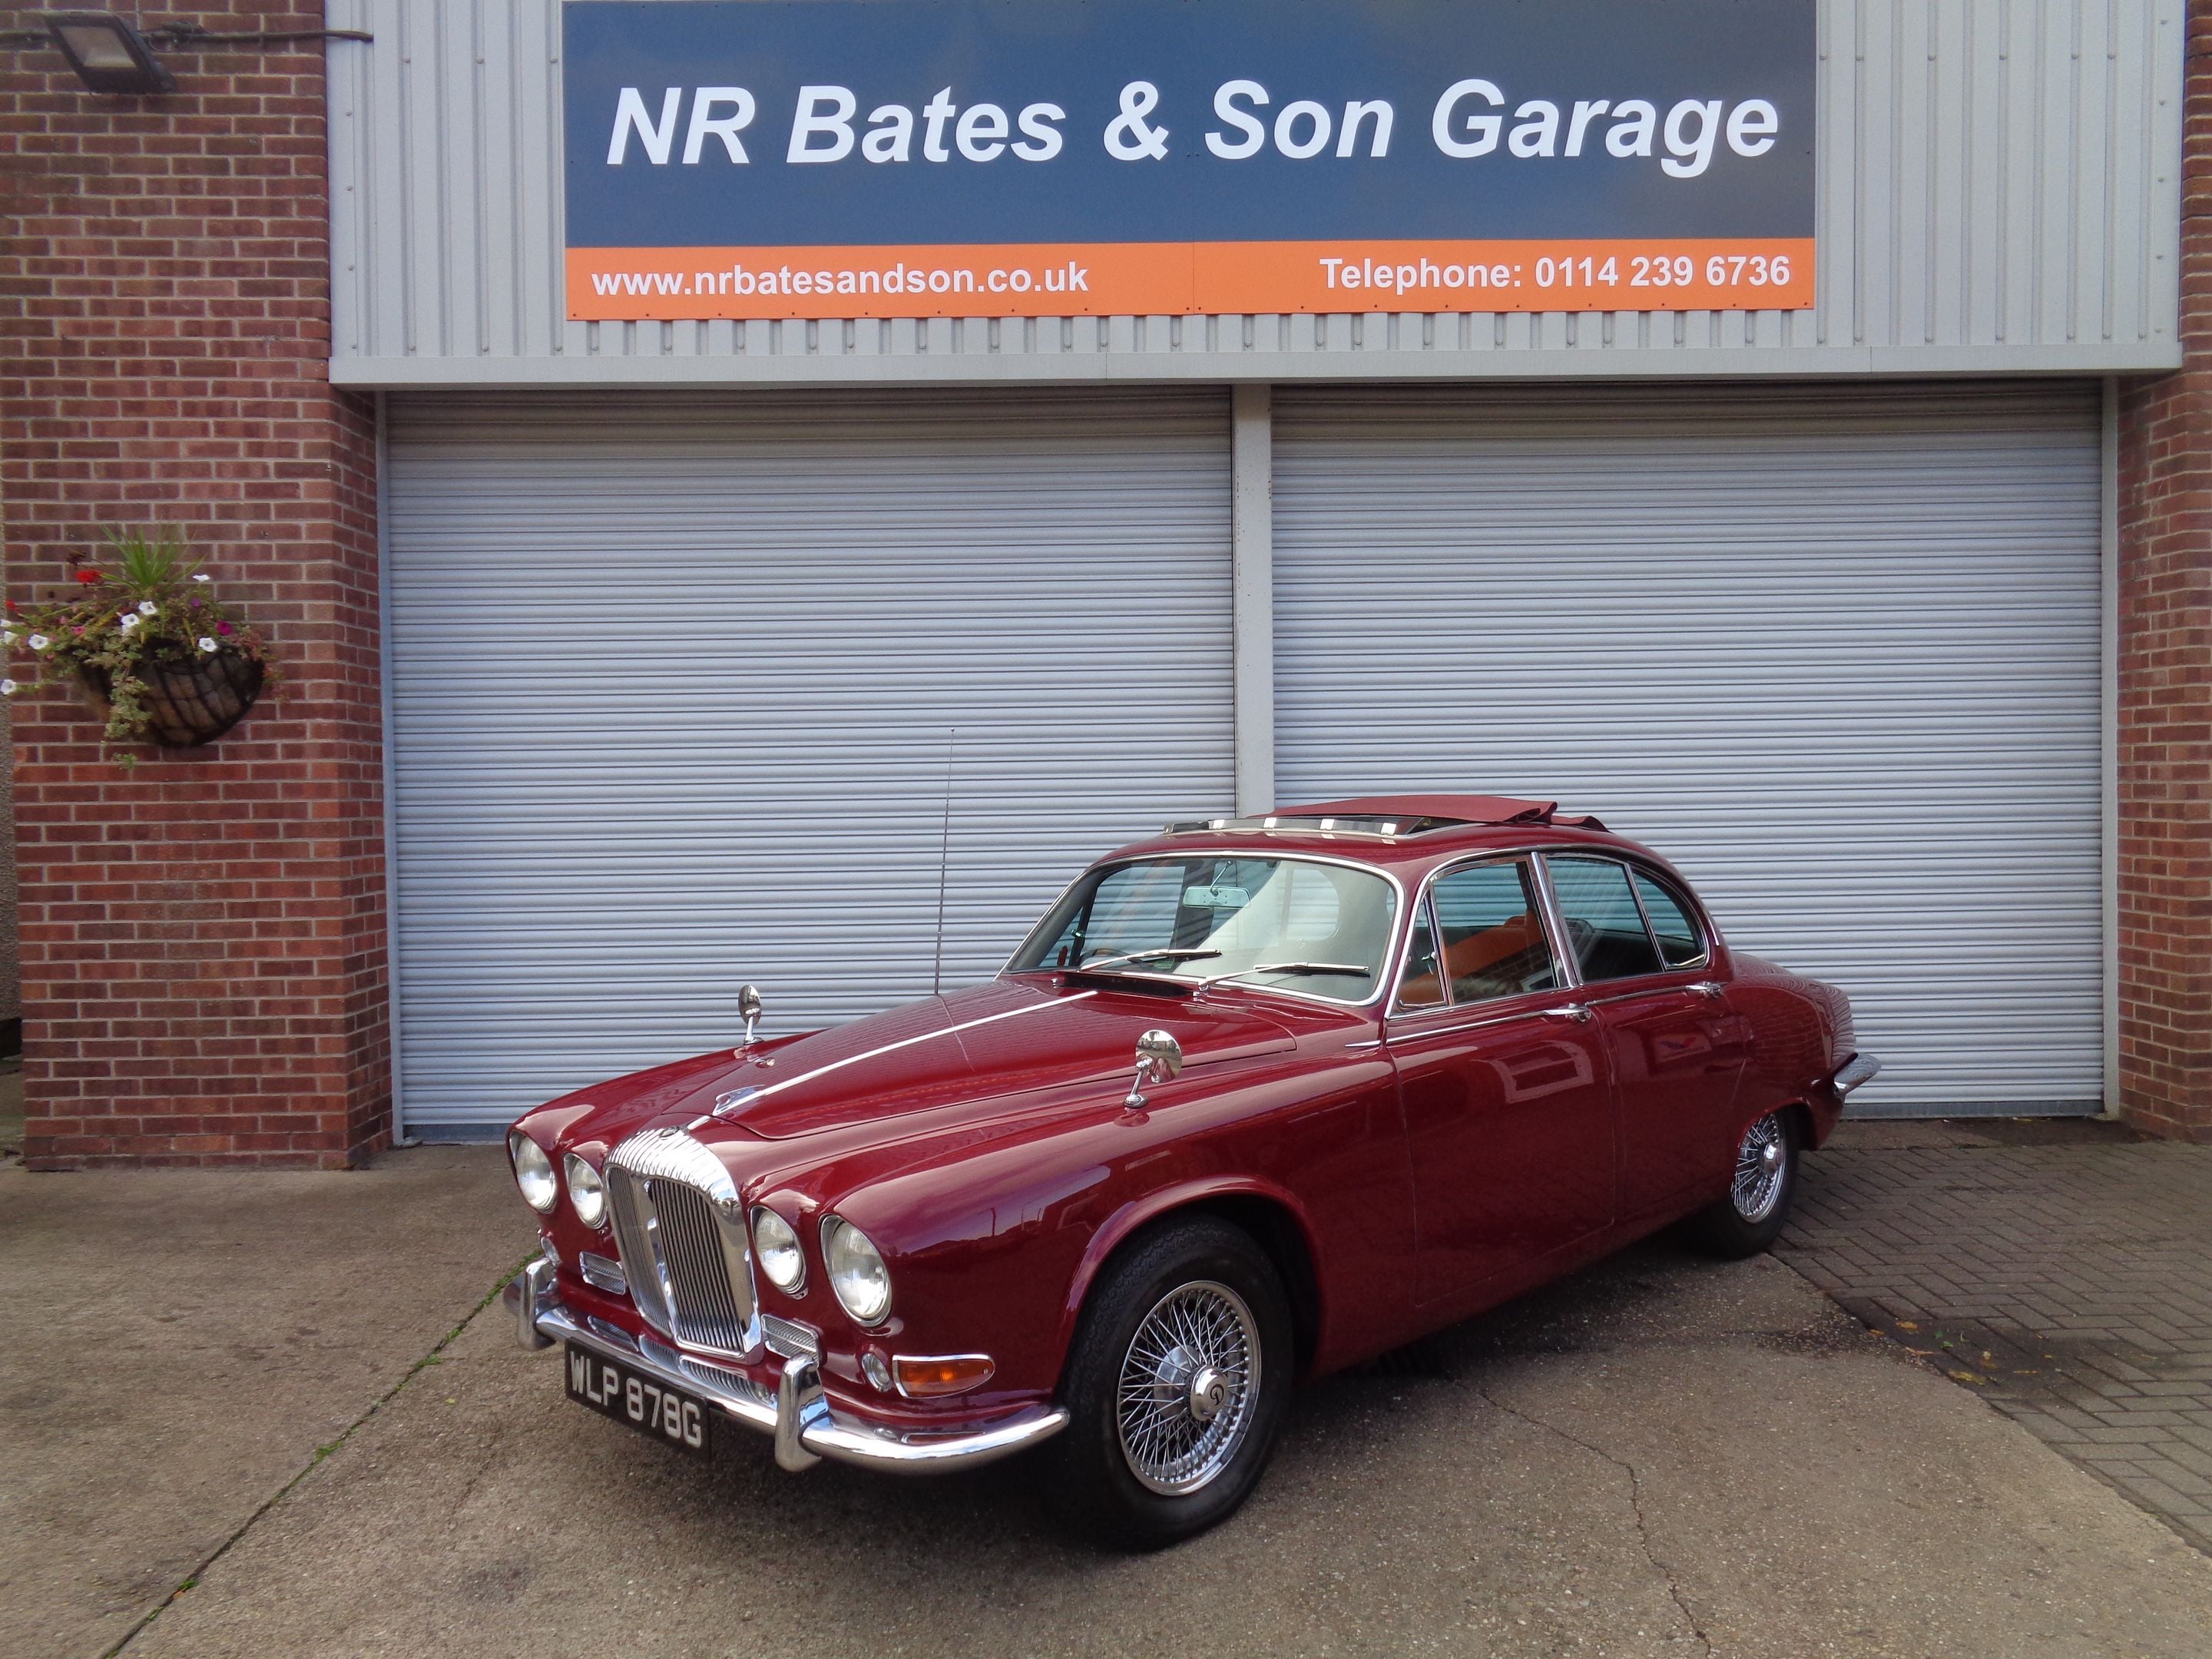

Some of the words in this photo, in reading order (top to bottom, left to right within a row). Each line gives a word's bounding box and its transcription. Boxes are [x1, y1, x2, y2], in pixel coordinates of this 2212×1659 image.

[607, 87, 756, 165] NR
[786, 85, 1066, 164] Bates
[1104, 81, 1169, 161] &
[1204, 79, 1394, 160] Son
[1432, 78, 1778, 178] Garage
[591, 261, 1089, 296] www.nrbatesandson.co.uk
[1319, 257, 1522, 296] Telephone:
[1535, 257, 1619, 288] 0114
[1630, 256, 1694, 286] 239
[1706, 255, 1790, 286] 6736
[570, 1350, 619, 1406] WLP
[626, 1377, 702, 1448] 878G
